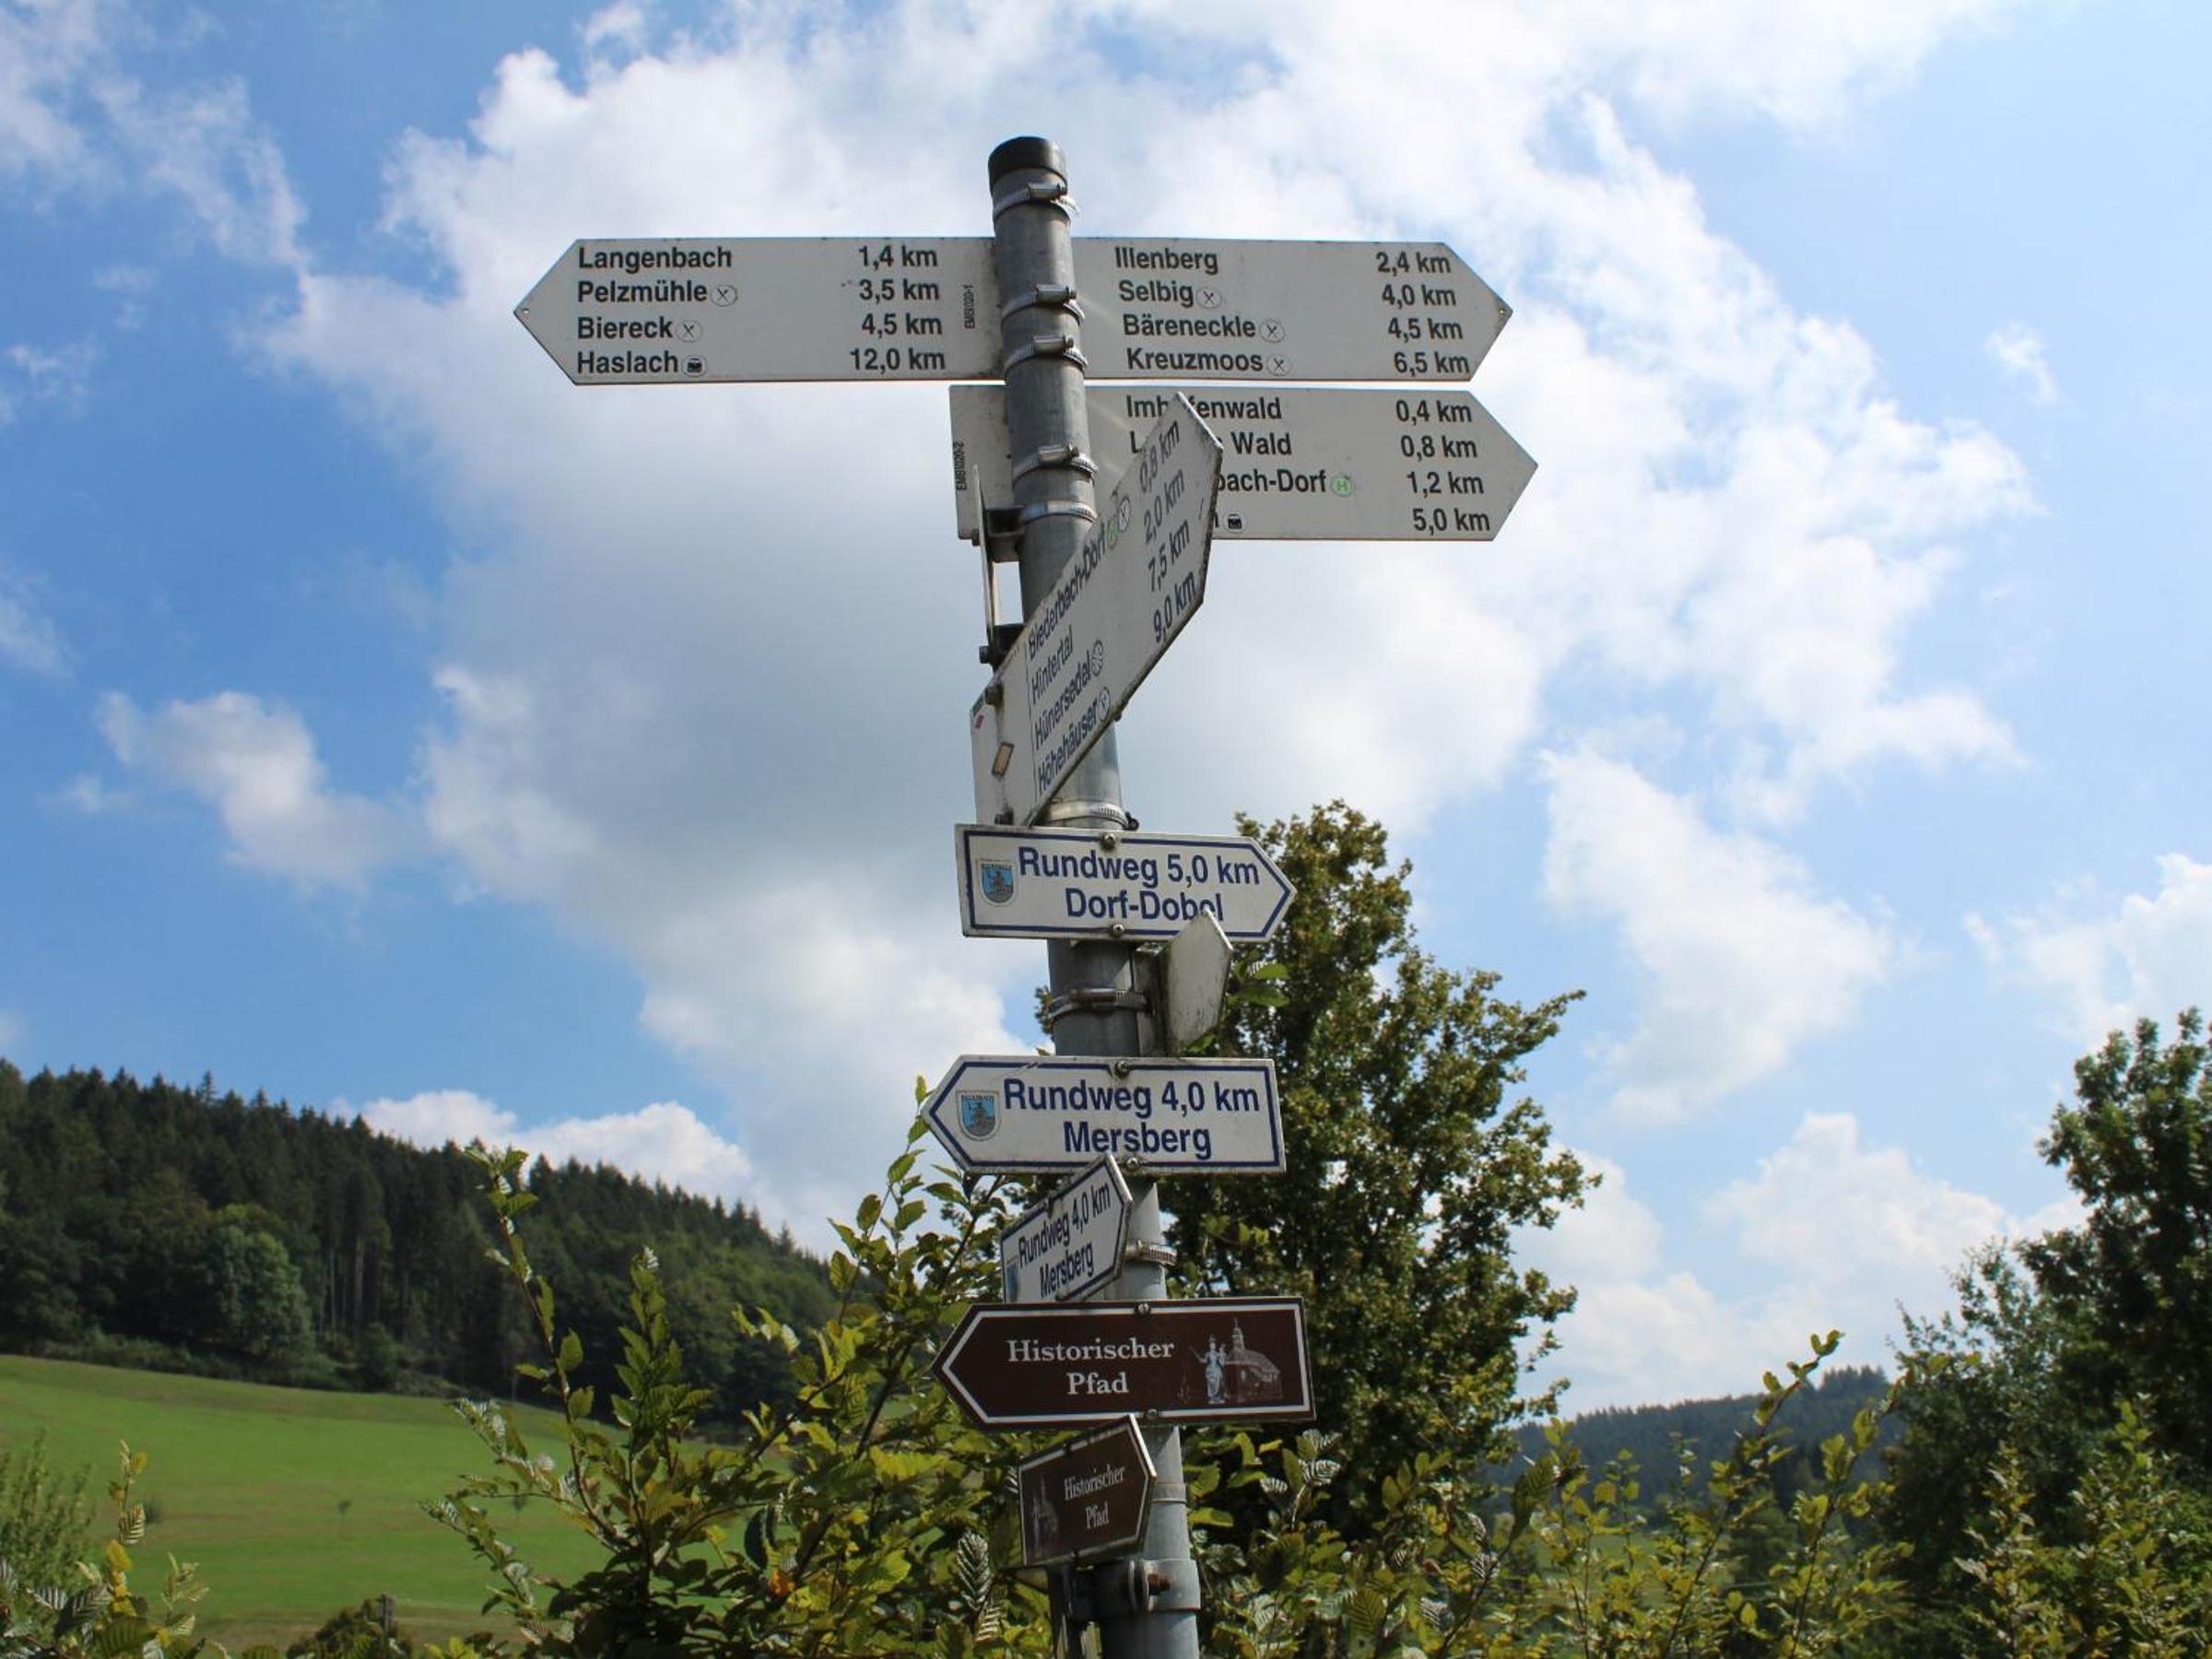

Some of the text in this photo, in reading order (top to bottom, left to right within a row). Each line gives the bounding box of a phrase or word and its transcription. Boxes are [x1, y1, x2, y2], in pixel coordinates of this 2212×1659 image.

[579, 247, 732, 274] Langenbach
[859, 246, 937, 270] 1,4 km
[1114, 247, 1218, 276] Illenberg
[1376, 252, 1451, 276] 2,4 km
[578, 280, 708, 302] Pelzmühle
[859, 279, 939, 304] 3,5 km
[1119, 279, 1194, 308] Selbig
[1382, 284, 1456, 310] 4,0 km
[578, 317, 673, 339] Biereck
[862, 313, 943, 339] 4,5 km
[1123, 313, 1256, 337] Bäreneckle
[1388, 318, 1463, 343] 4,5 km
[577, 350, 678, 373] Haslach
[850, 347, 946, 374] 12,0 km
[1126, 347, 1264, 371] Kreuzmoos
[1394, 351, 1470, 376] 6,5 km
[1126, 395, 1282, 419] Imhenwald
[1396, 400, 1472, 426] 0,4 km
[1140, 421, 1180, 493] 0,8 km
[1231, 432, 1292, 455] Wald
[1401, 435, 1477, 462] 0,8 km
[1406, 471, 1484, 499] 1,2 km
[1144, 469, 1184, 544] 2,0 km
[1413, 508, 1490, 535] 5,0 km
[1148, 520, 1189, 592] 7,5 km
[1029, 522, 1106, 662] Biederbach-Dorf
[1154, 571, 1194, 643] 9,0 km
[1031, 626, 1073, 705] Hintertal
[1018, 846, 1259, 888] Rundweg 5,0 km
[1004, 1078, 1259, 1118] Rundweg 4,0 km
[1064, 1122, 1210, 1159] Mersberg
[1018, 1182, 1111, 1268] Rundweg 4,0 km
[1040, 1242, 1093, 1298] Mersberg
[1006, 1336, 1174, 1362] Historischer
[1066, 1371, 1129, 1395] Pfad
[1065, 1463, 1125, 1500] Historischer
[1086, 1500, 1110, 1529] Pfad
